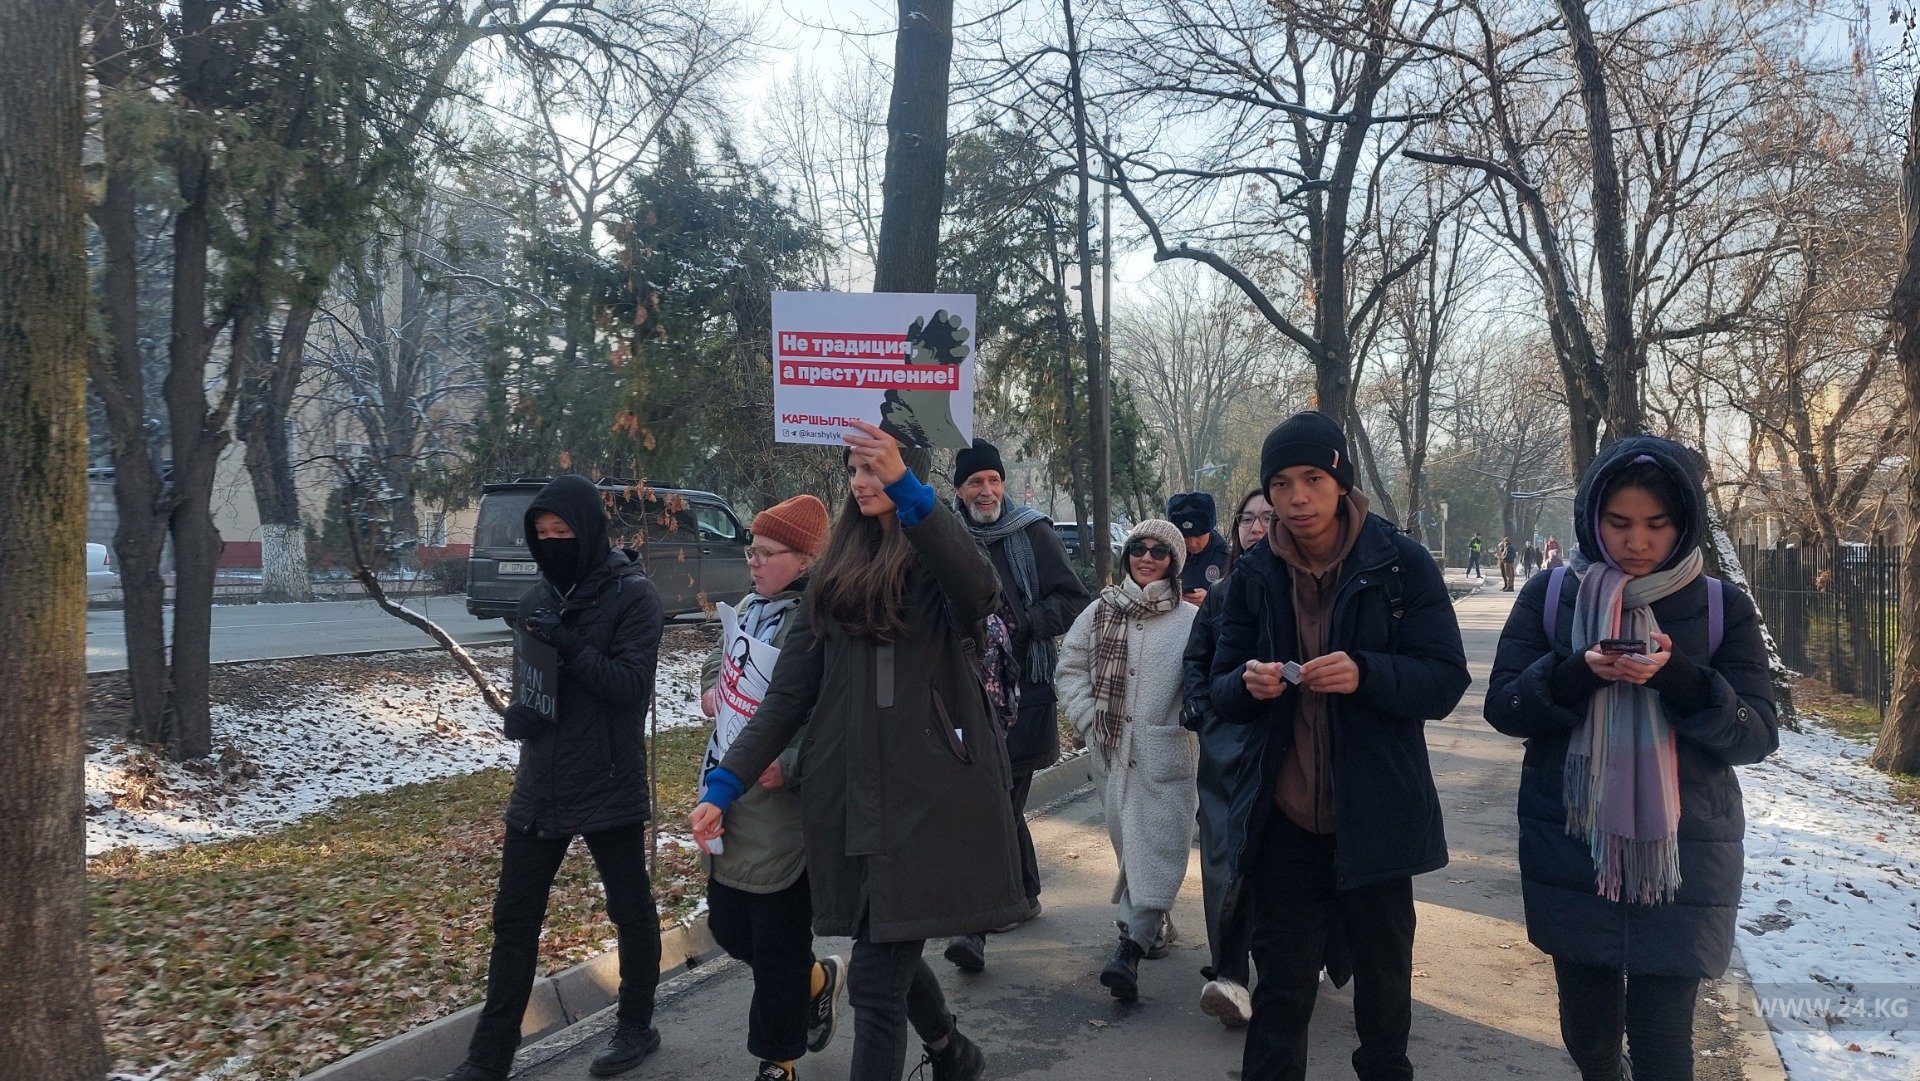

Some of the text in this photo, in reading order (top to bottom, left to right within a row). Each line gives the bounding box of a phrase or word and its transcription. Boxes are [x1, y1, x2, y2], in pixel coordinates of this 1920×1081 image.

[782, 334, 919, 359] Не традиция,
[783, 365, 955, 387] а преступление!
[781, 413, 860, 429] КАРШЫЛЫ
[798, 427, 842, 440] @karshylyk
